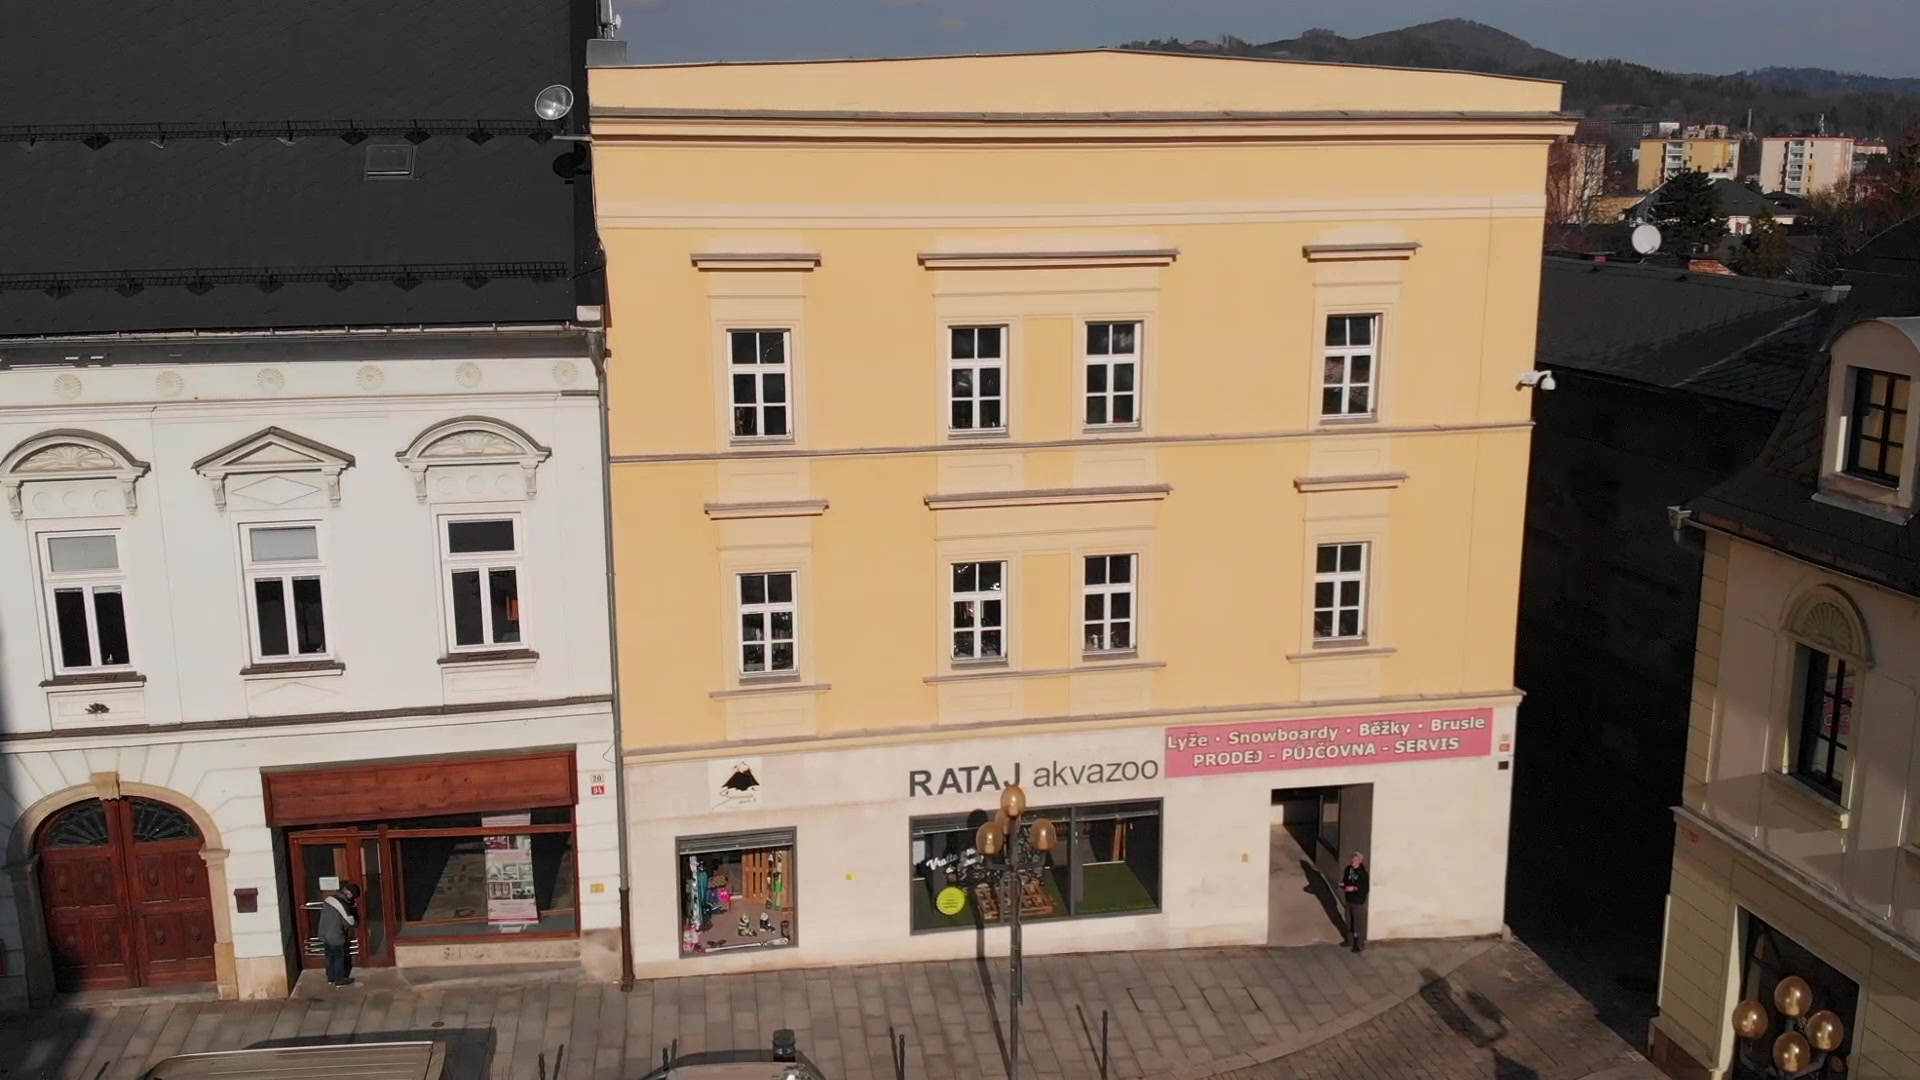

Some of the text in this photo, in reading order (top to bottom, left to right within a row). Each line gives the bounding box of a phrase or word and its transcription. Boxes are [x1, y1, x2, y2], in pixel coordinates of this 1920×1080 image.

[1167, 716, 1485, 751] Lyže Snowboardy Běžky Brusle
[1193, 737, 1460, 767] PRODEJ PŮJČOVNA SERVIS
[909, 760, 1159, 797] RATAJ akvazoo
